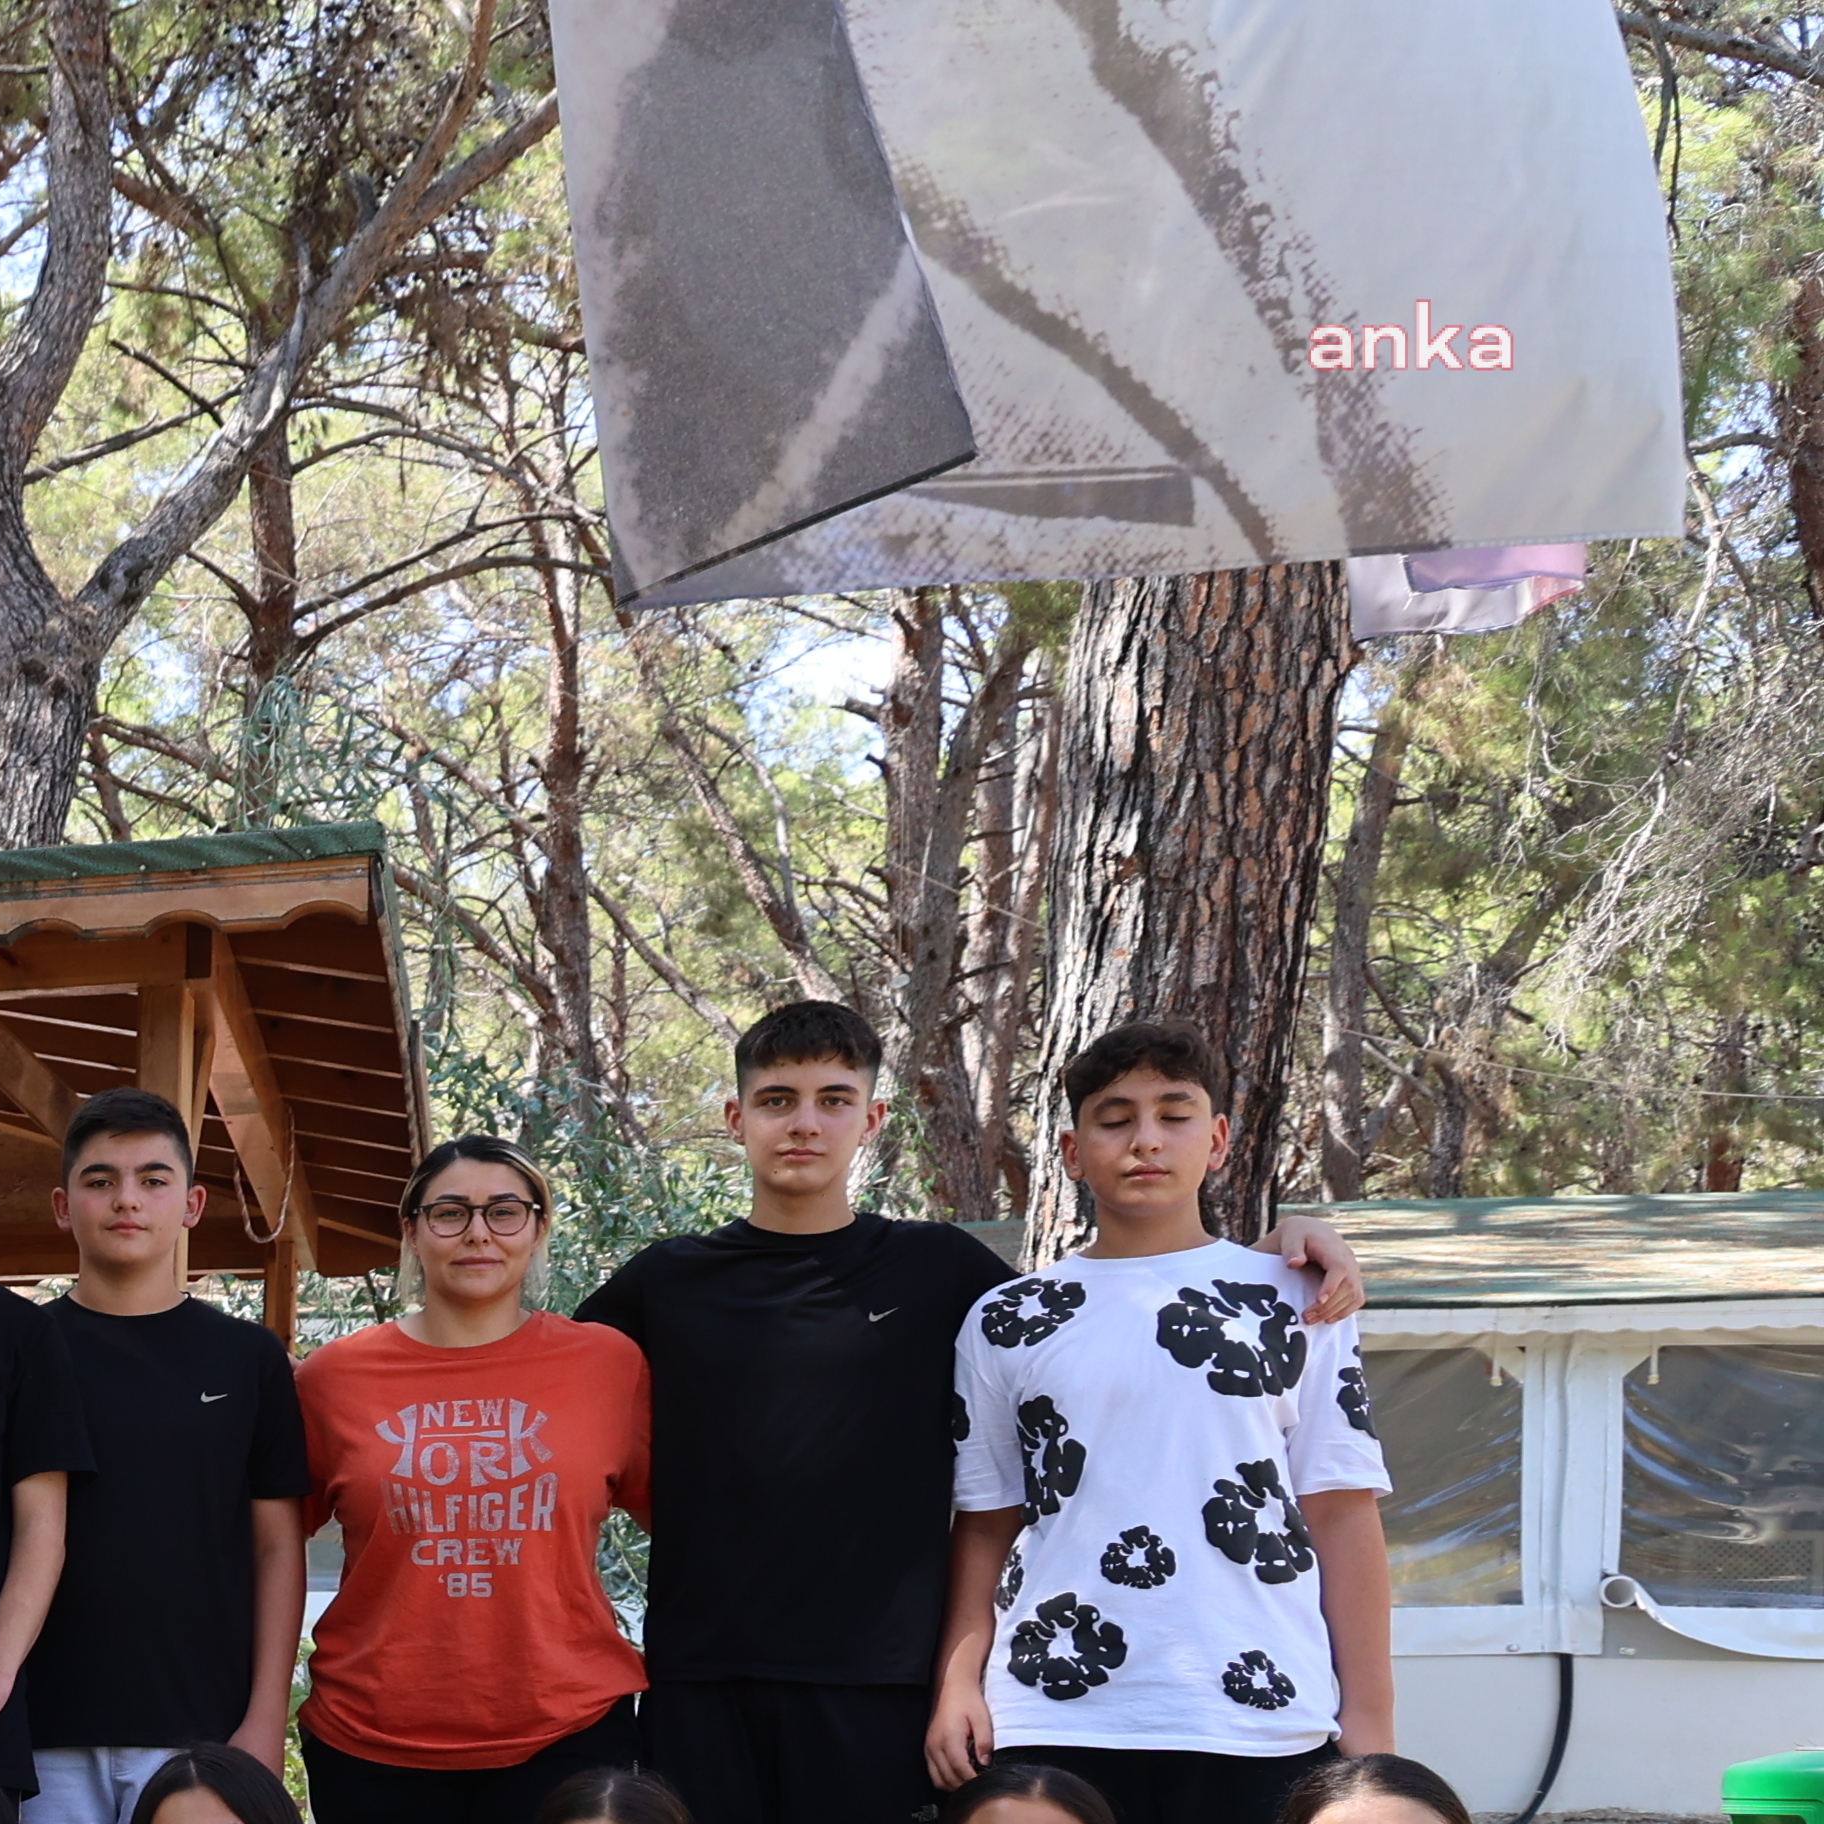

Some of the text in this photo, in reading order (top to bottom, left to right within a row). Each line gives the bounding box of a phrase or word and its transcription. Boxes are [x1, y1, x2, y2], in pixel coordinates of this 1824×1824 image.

[420, 1398, 505, 1429] NEW
[374, 1398, 555, 1487] YORK
[380, 1472, 559, 1535] HILFIGER
[410, 1537, 524, 1566] CREW
